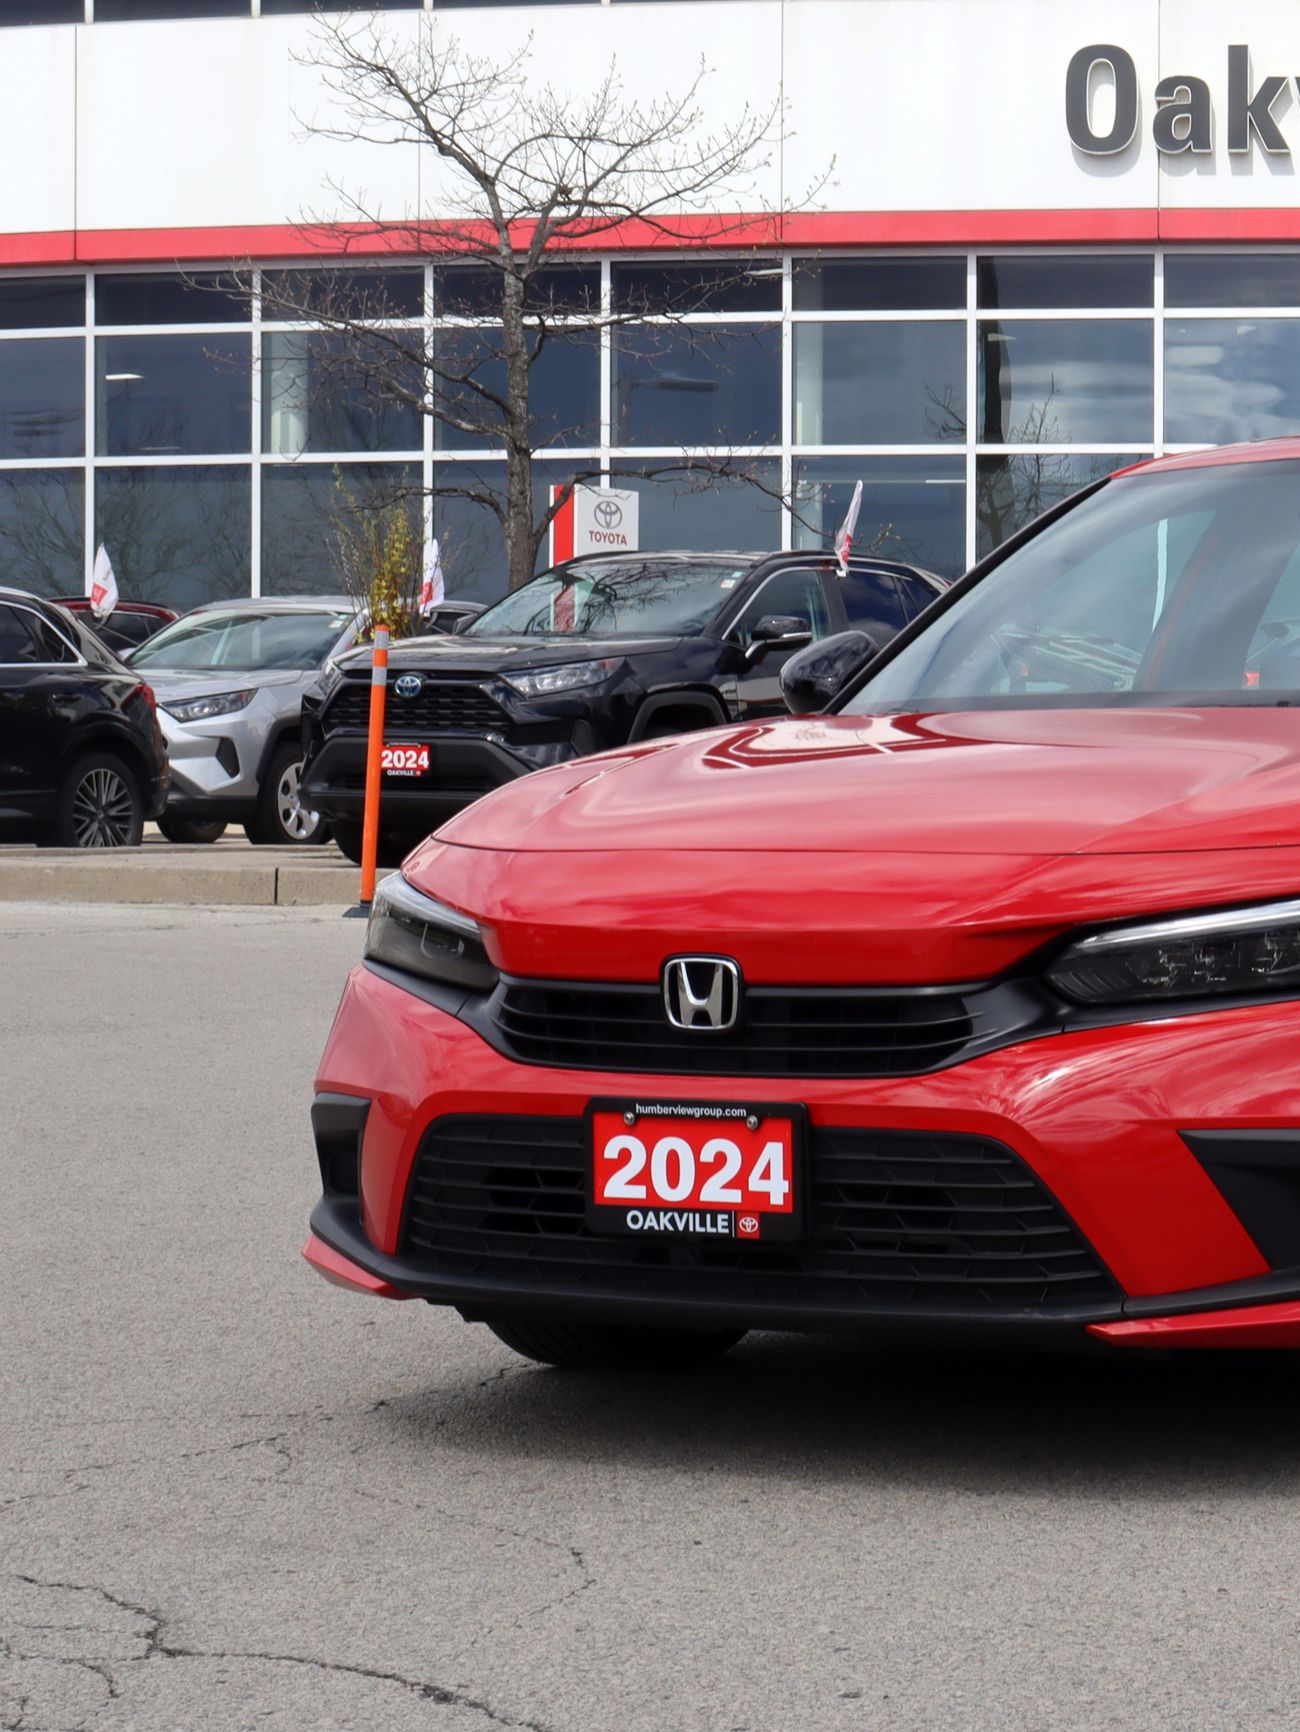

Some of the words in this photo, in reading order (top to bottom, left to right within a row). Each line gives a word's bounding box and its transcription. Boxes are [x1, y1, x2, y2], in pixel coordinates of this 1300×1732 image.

[588, 530, 628, 546] TOYOTA
[381, 749, 429, 769] 2024
[635, 1103, 747, 1118] humberviewgroup.com
[603, 1134, 789, 1206] 2024
[626, 1210, 730, 1234] OAKVILLE
